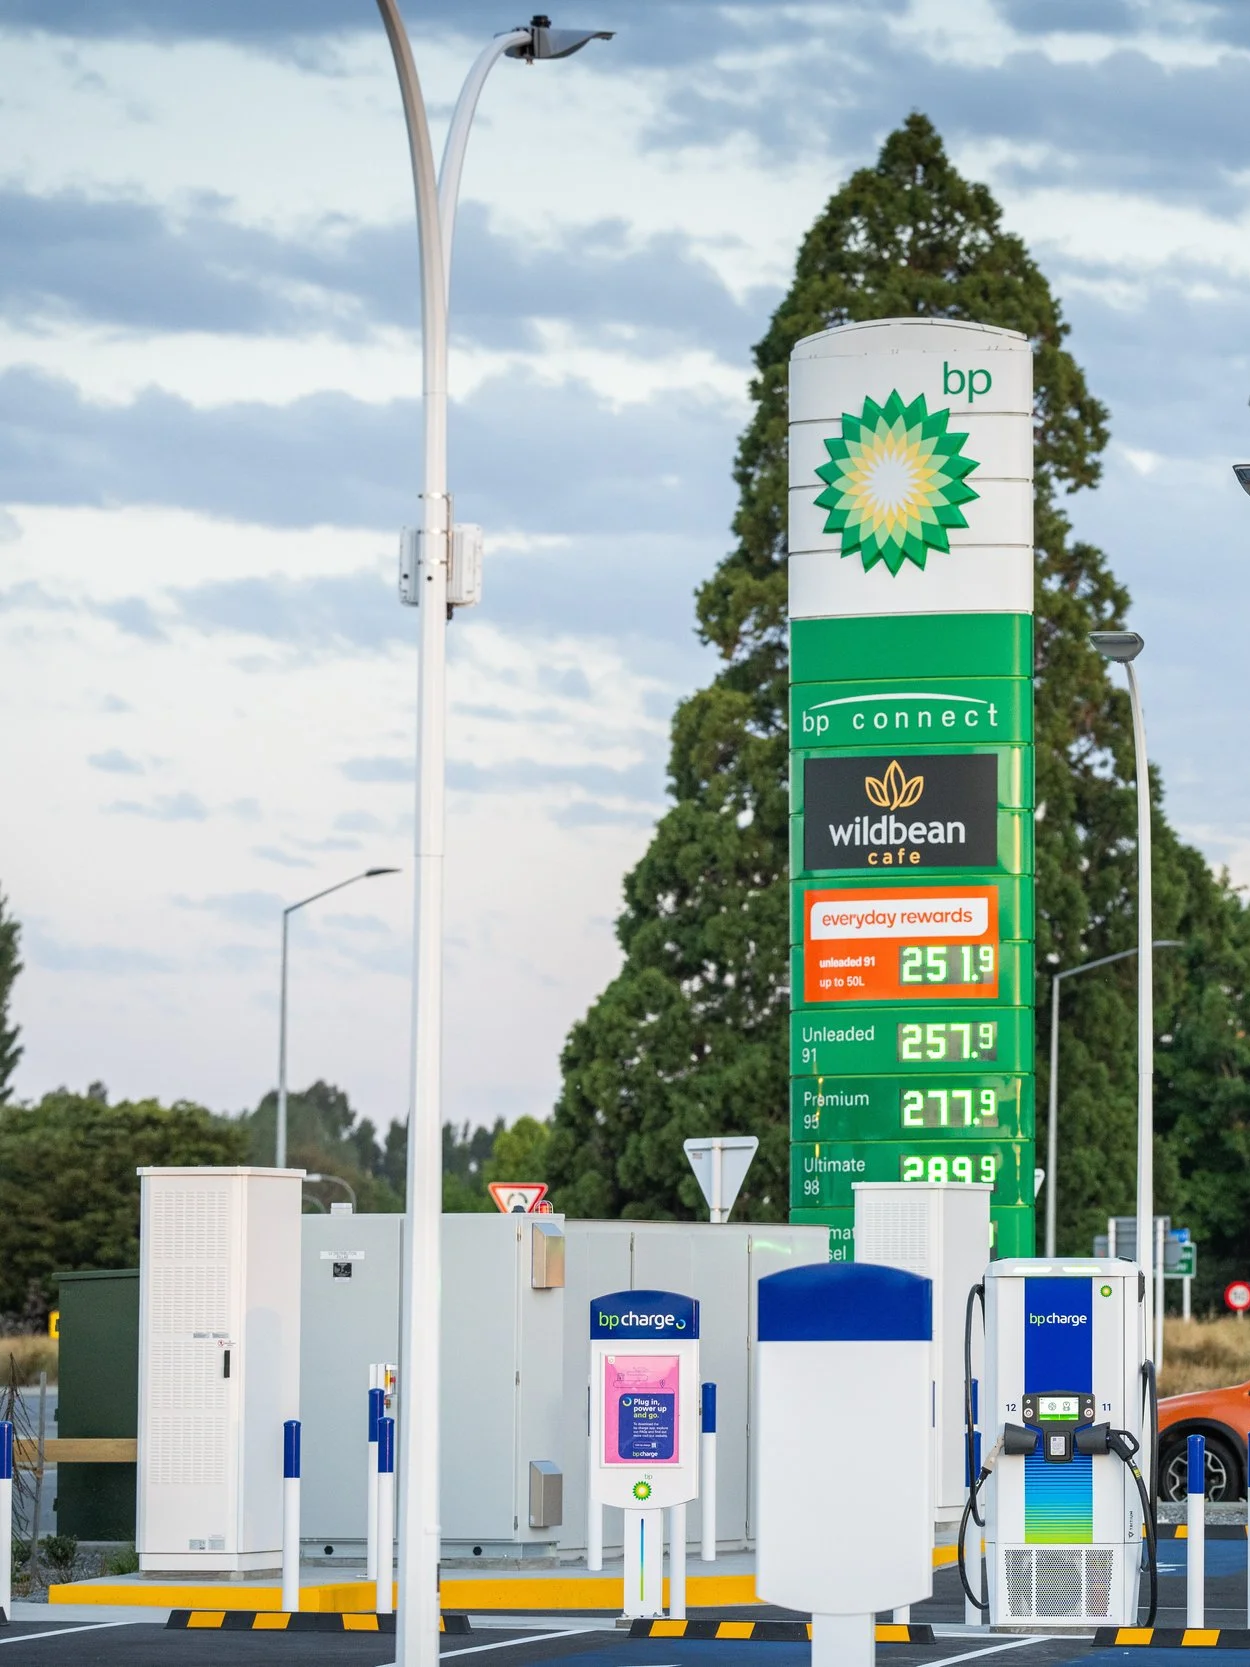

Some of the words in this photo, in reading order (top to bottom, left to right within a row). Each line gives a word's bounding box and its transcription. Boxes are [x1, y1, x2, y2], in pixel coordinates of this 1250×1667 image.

[943, 361, 992, 403] bp
[802, 711, 829, 736] bp
[853, 703, 998, 730] connect
[829, 814, 966, 846] wildbean
[868, 848, 921, 864] cafe
[822, 910, 897, 929] everyday
[900, 908, 973, 924] rewards
[819, 957, 862, 968] unleaded
[864, 957, 875, 967] 91
[902, 946, 994, 982] 251.9
[819, 978, 832, 989] up
[834, 977, 844, 987] to
[847, 976, 865, 986] 50L
[802, 1026, 874, 1043] Unleaded
[902, 1023, 993, 1059] 257.9
[802, 1048, 817, 1063] 91
[804, 1091, 869, 1107] Premium
[903, 1089, 995, 1126] 277.9
[804, 1115, 819, 1129] 95
[804, 1157, 865, 1172] Ultimate
[903, 1156, 995, 1183] 2899
[804, 1180, 820, 1195] 98
[634, 1398, 649, 1406] Plug
[1006, 1404, 1016, 1412] 12
[1102, 1403, 1111, 1411] 11
